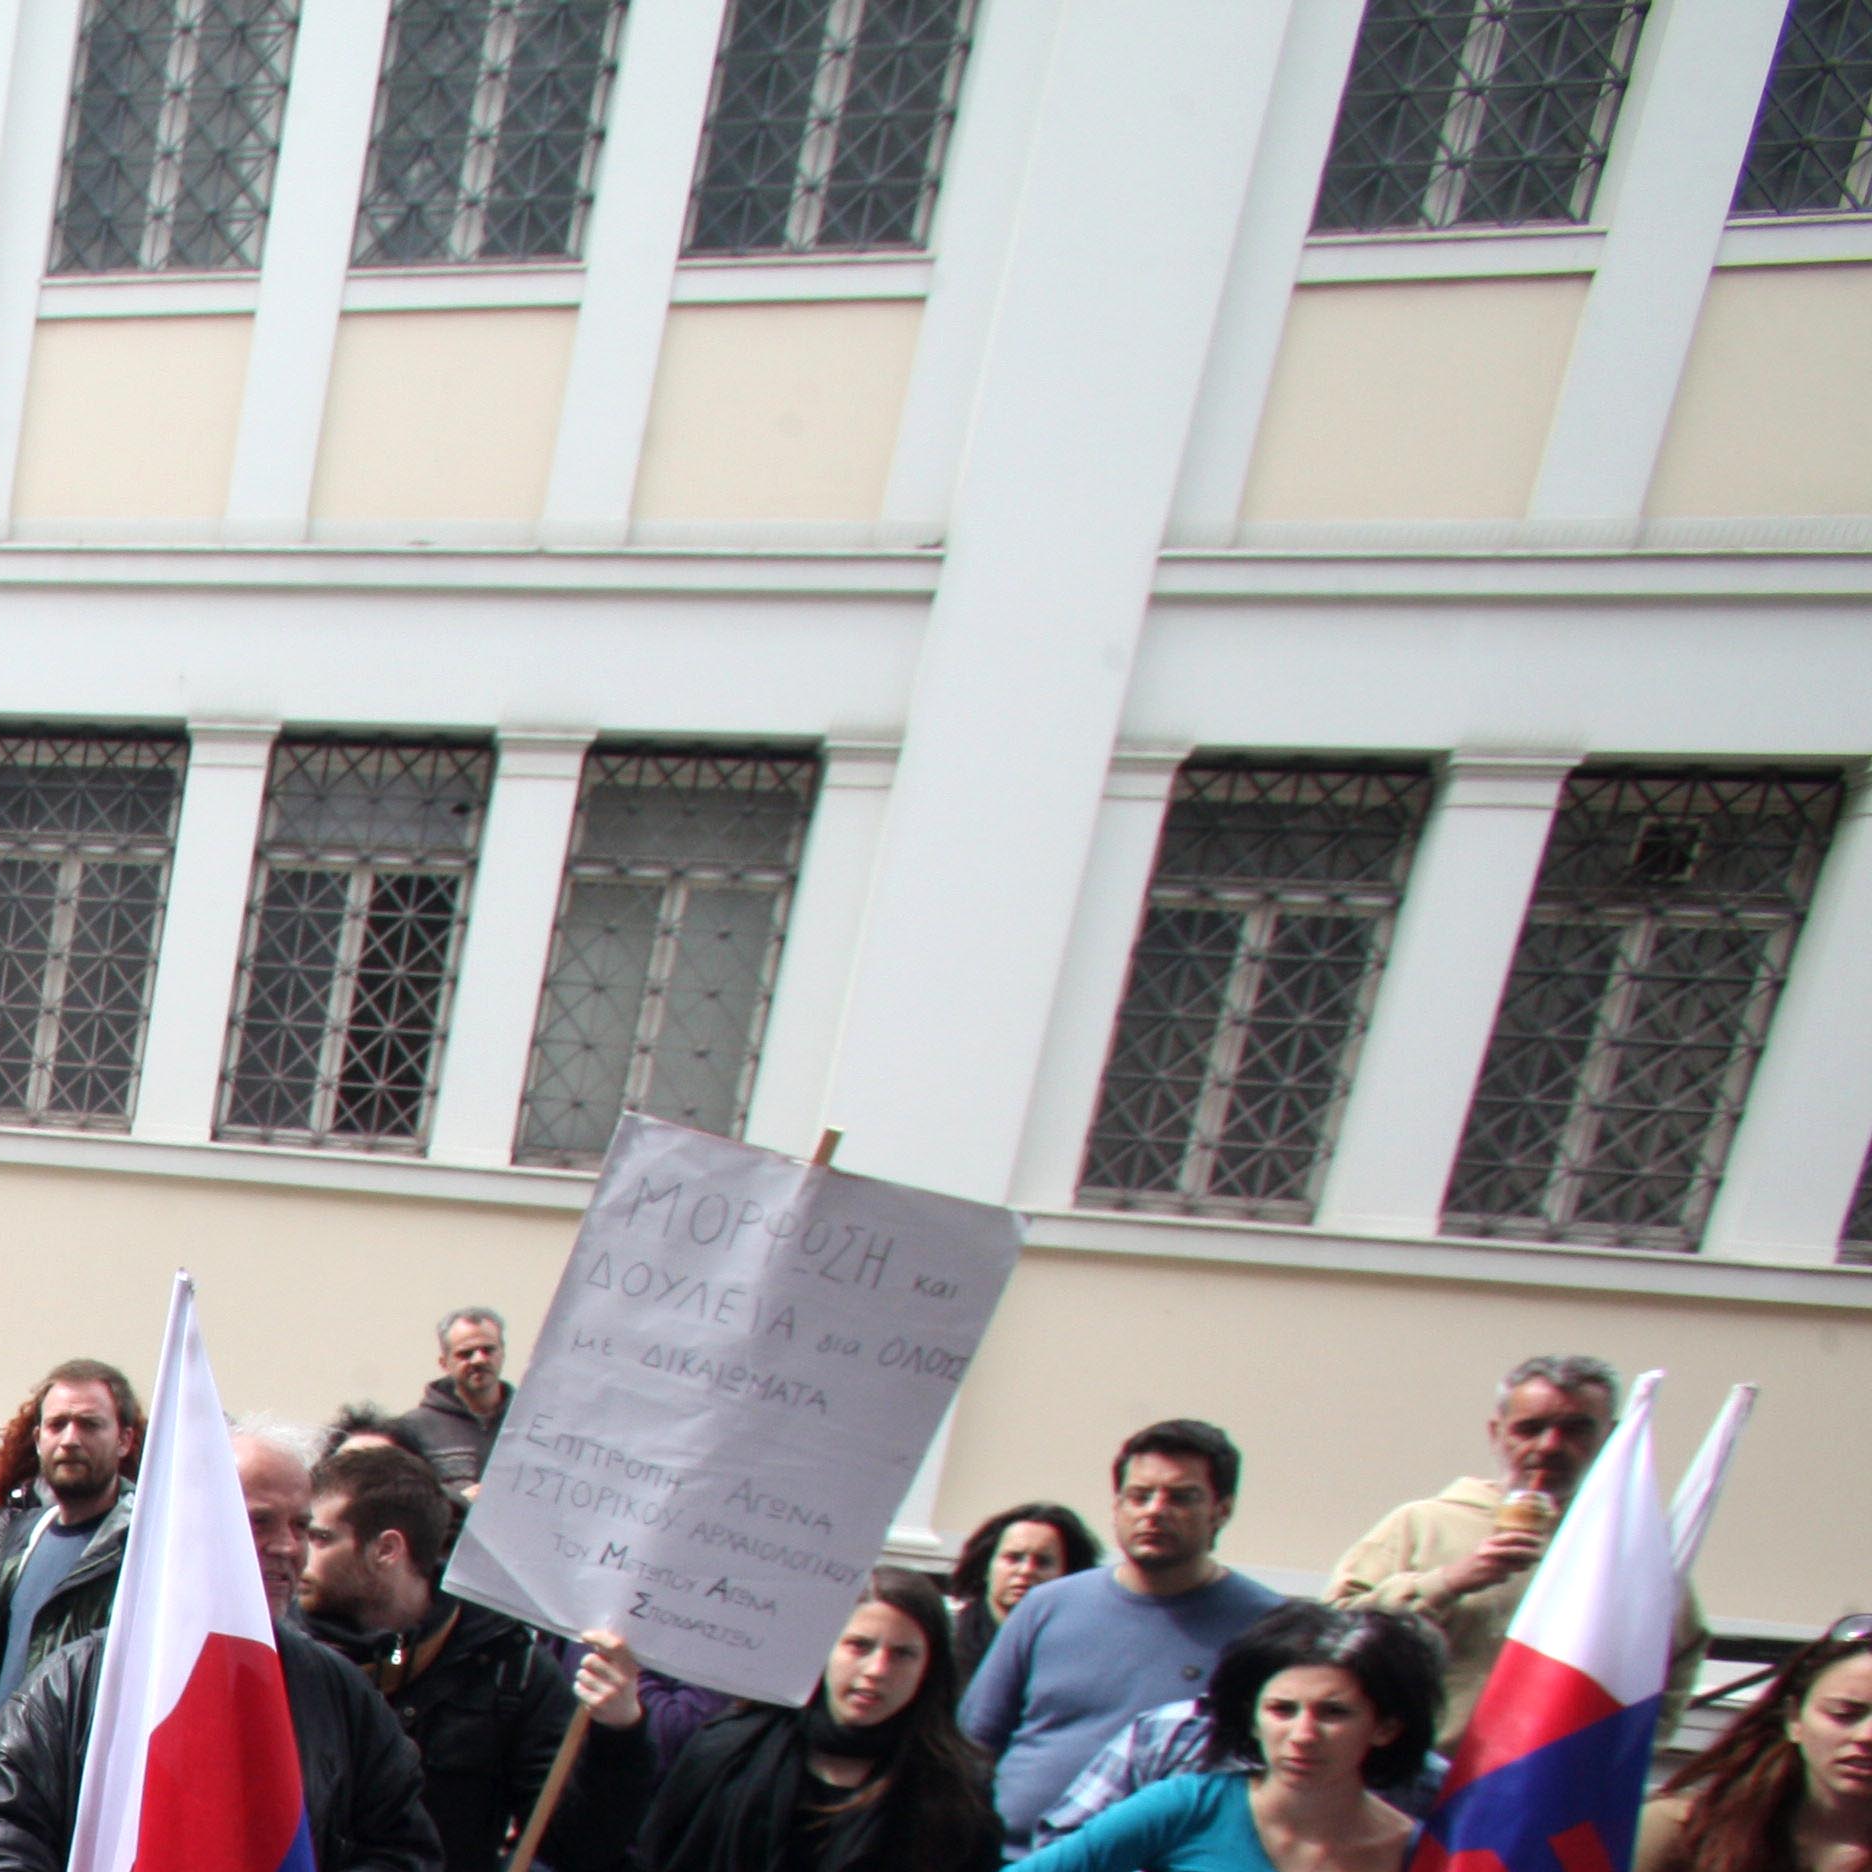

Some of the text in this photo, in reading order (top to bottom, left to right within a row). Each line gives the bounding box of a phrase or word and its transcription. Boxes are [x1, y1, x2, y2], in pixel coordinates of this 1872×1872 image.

[586, 1251, 796, 1341] ΔΟΥΛΕΙΑ
[526, 1412, 686, 1496] ΕΠΙΤΡΟΠΗ
[510, 1462, 685, 1533] ΙΣΤΟΡΙΚΟΥ
[598, 1540, 699, 1594] ΜΤΩΠΟΥ
